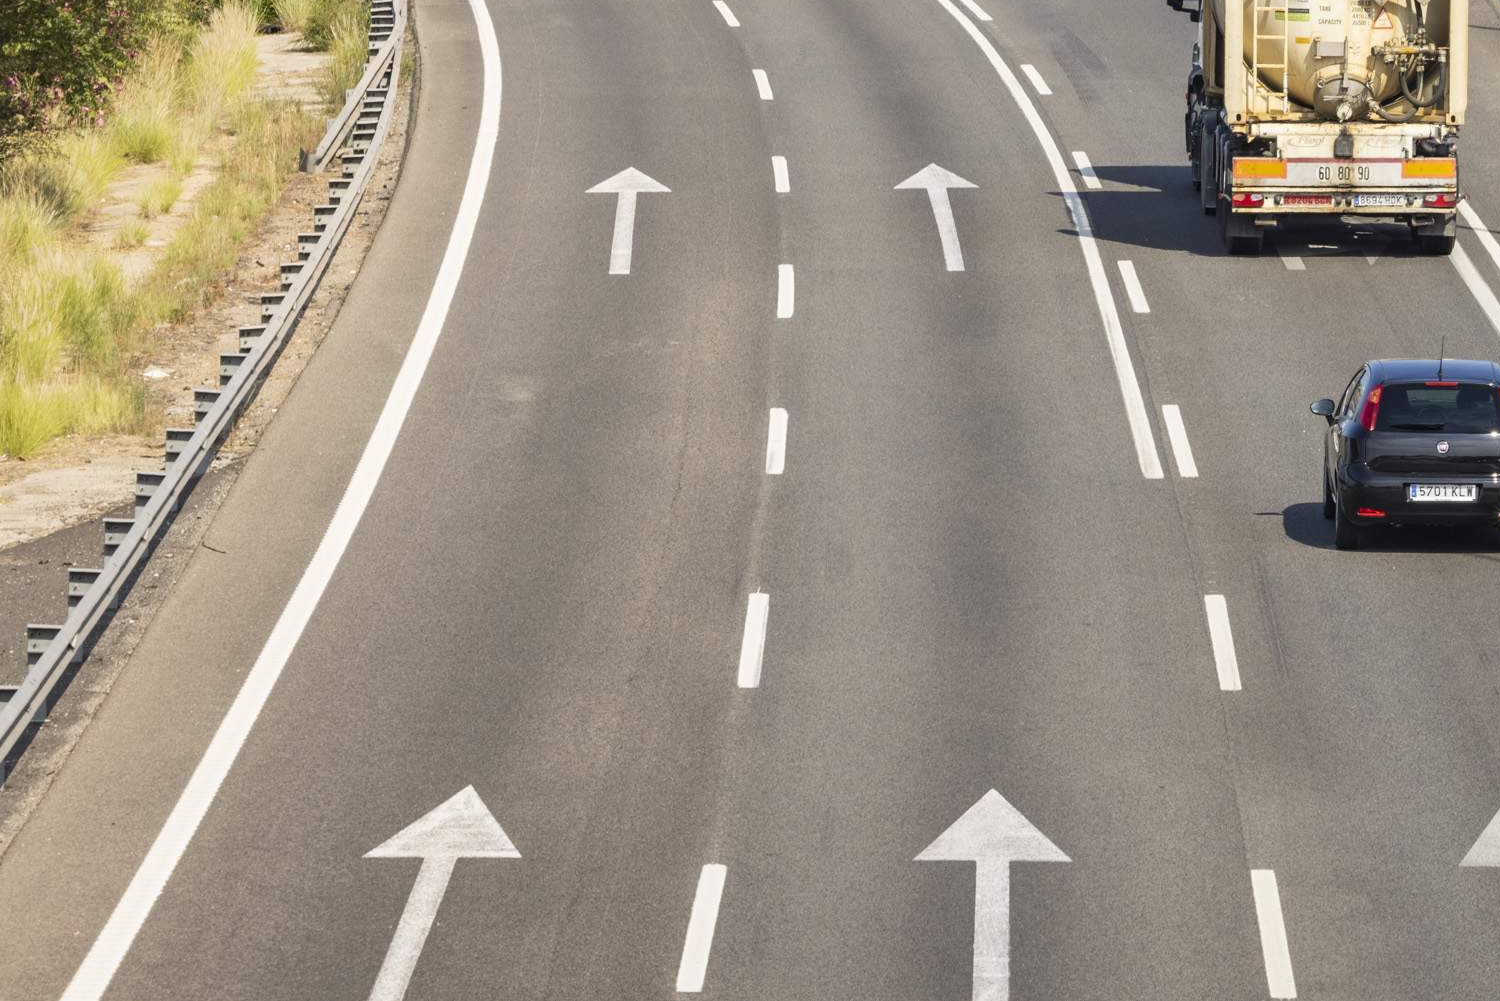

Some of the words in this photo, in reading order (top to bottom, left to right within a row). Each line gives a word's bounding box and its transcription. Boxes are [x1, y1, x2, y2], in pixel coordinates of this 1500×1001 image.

[1318, 166, 1331, 180] 60
[1338, 166, 1350, 180] 80
[1357, 166, 1370, 180] 90
[1419, 486, 1449, 497] 5701
[1452, 486, 1473, 497] KLW
